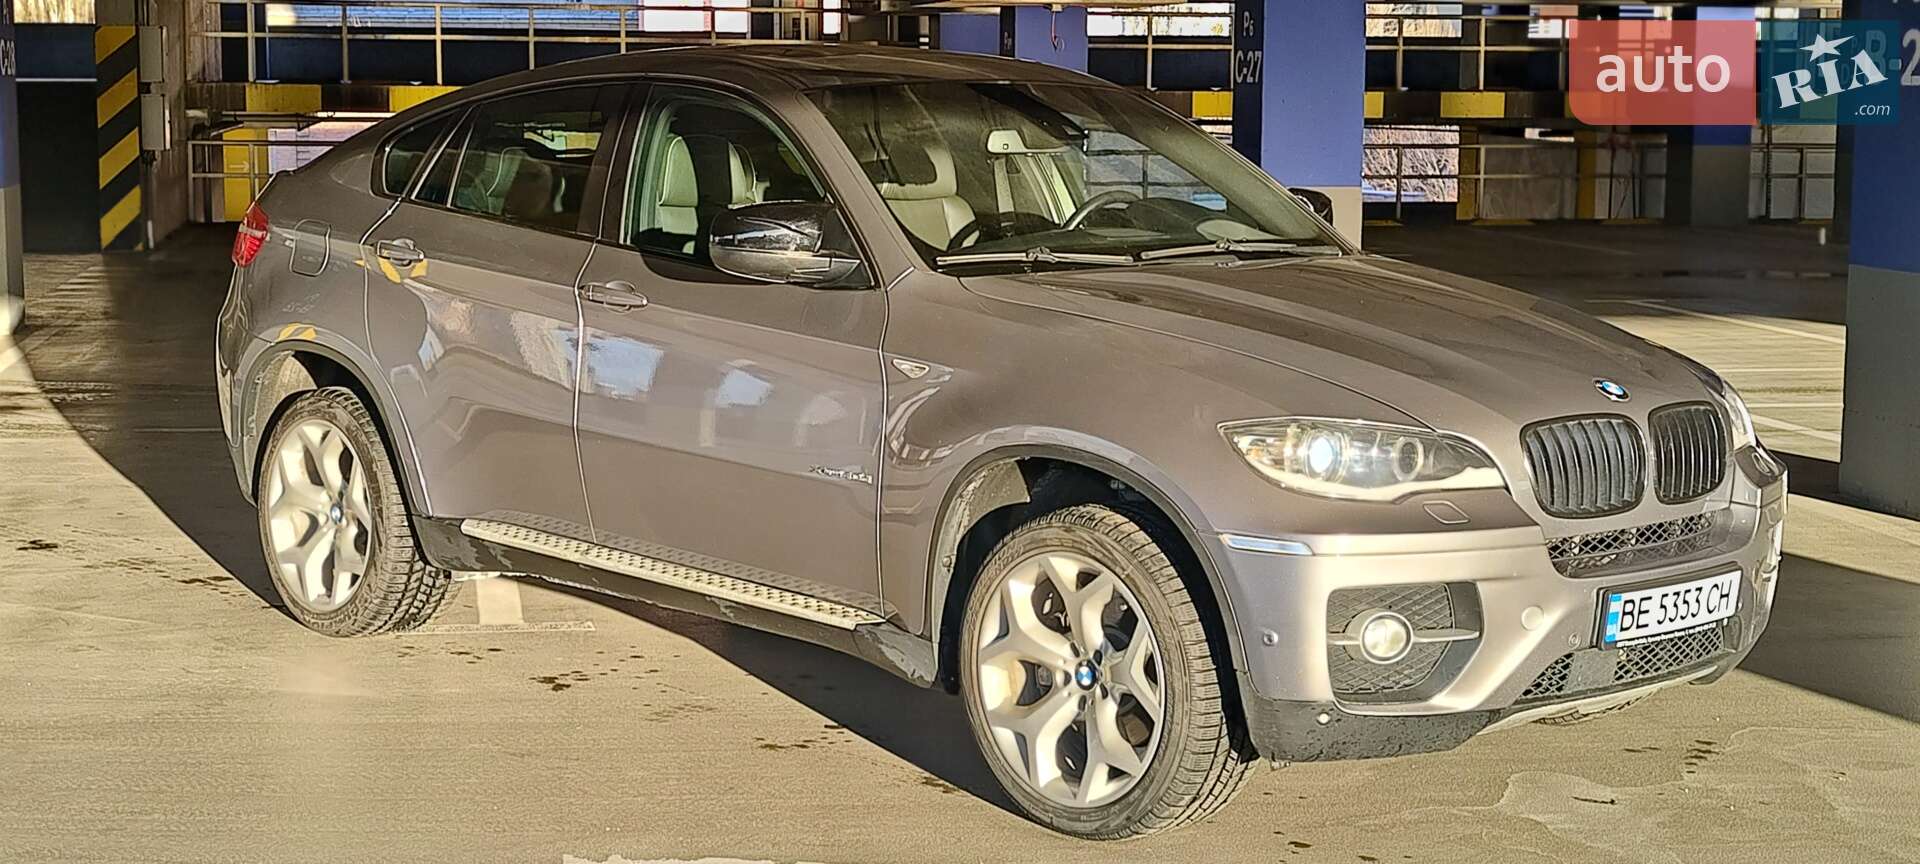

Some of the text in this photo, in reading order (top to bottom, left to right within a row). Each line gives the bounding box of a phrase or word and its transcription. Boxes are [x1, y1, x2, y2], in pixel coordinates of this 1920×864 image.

[1235, 50, 1262, 84] C-27
[1620, 579, 1733, 633] BE 5353 CH
